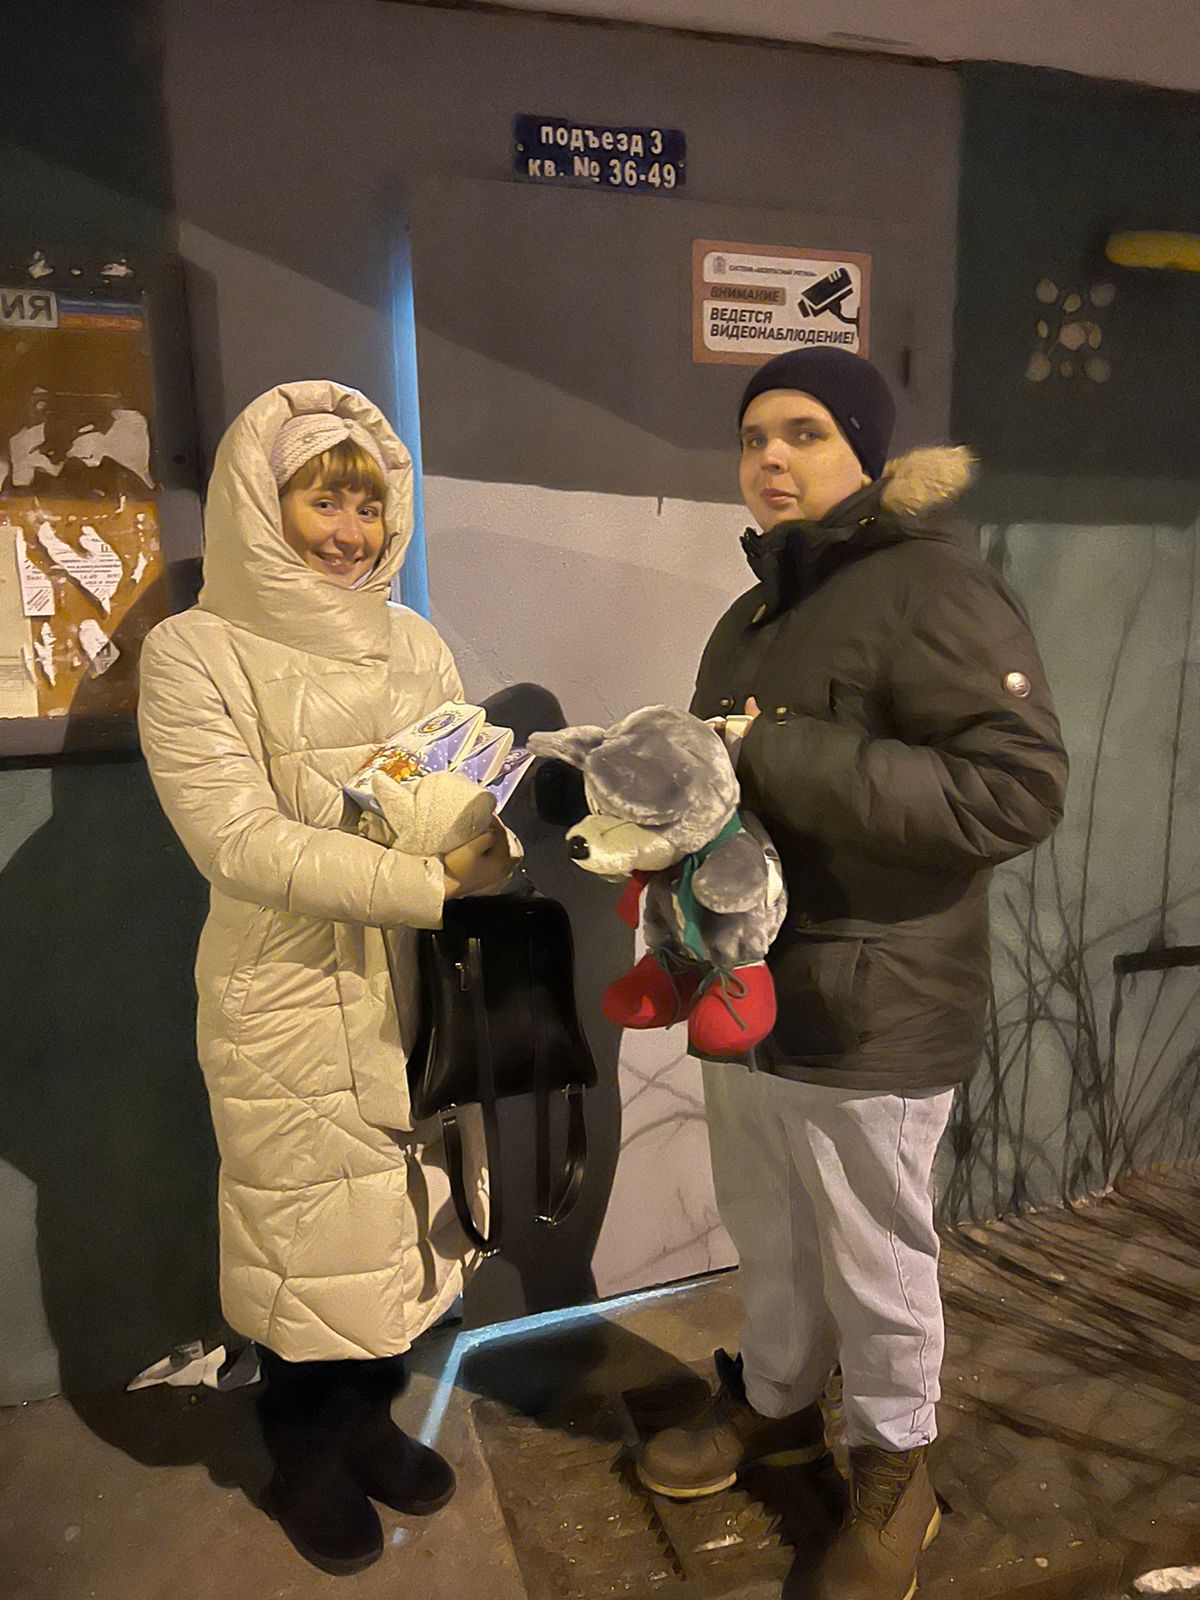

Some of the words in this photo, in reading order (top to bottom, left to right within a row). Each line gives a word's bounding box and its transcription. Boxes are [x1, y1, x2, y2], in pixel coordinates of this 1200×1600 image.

[650, 129, 663, 155] 3
[573, 155, 601, 183] №
[608, 158, 677, 189] 36-49
[710, 285, 780, 302] ВНИМАНИЕ
[709, 307, 773, 324] ВЕДЕТСЯ
[709, 323, 855, 345] ВИДЕОНАБЛЮДЕНИЕ!
